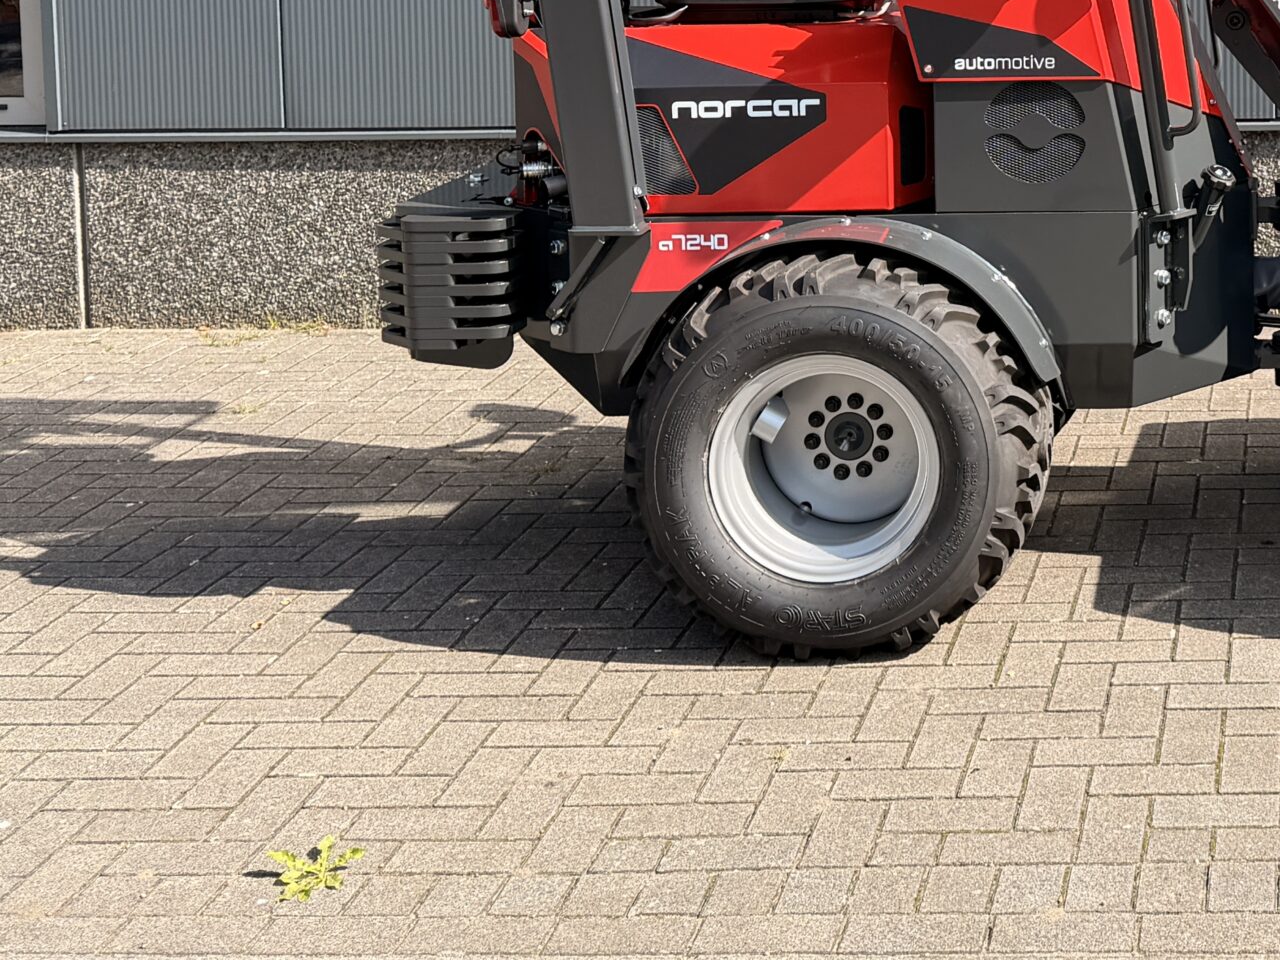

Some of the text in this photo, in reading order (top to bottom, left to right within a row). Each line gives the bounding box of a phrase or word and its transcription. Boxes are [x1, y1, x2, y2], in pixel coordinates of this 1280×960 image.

[954, 54, 1056, 70] automotive
[671, 98, 821, 119] norcar
[658, 233, 729, 251] a7240
